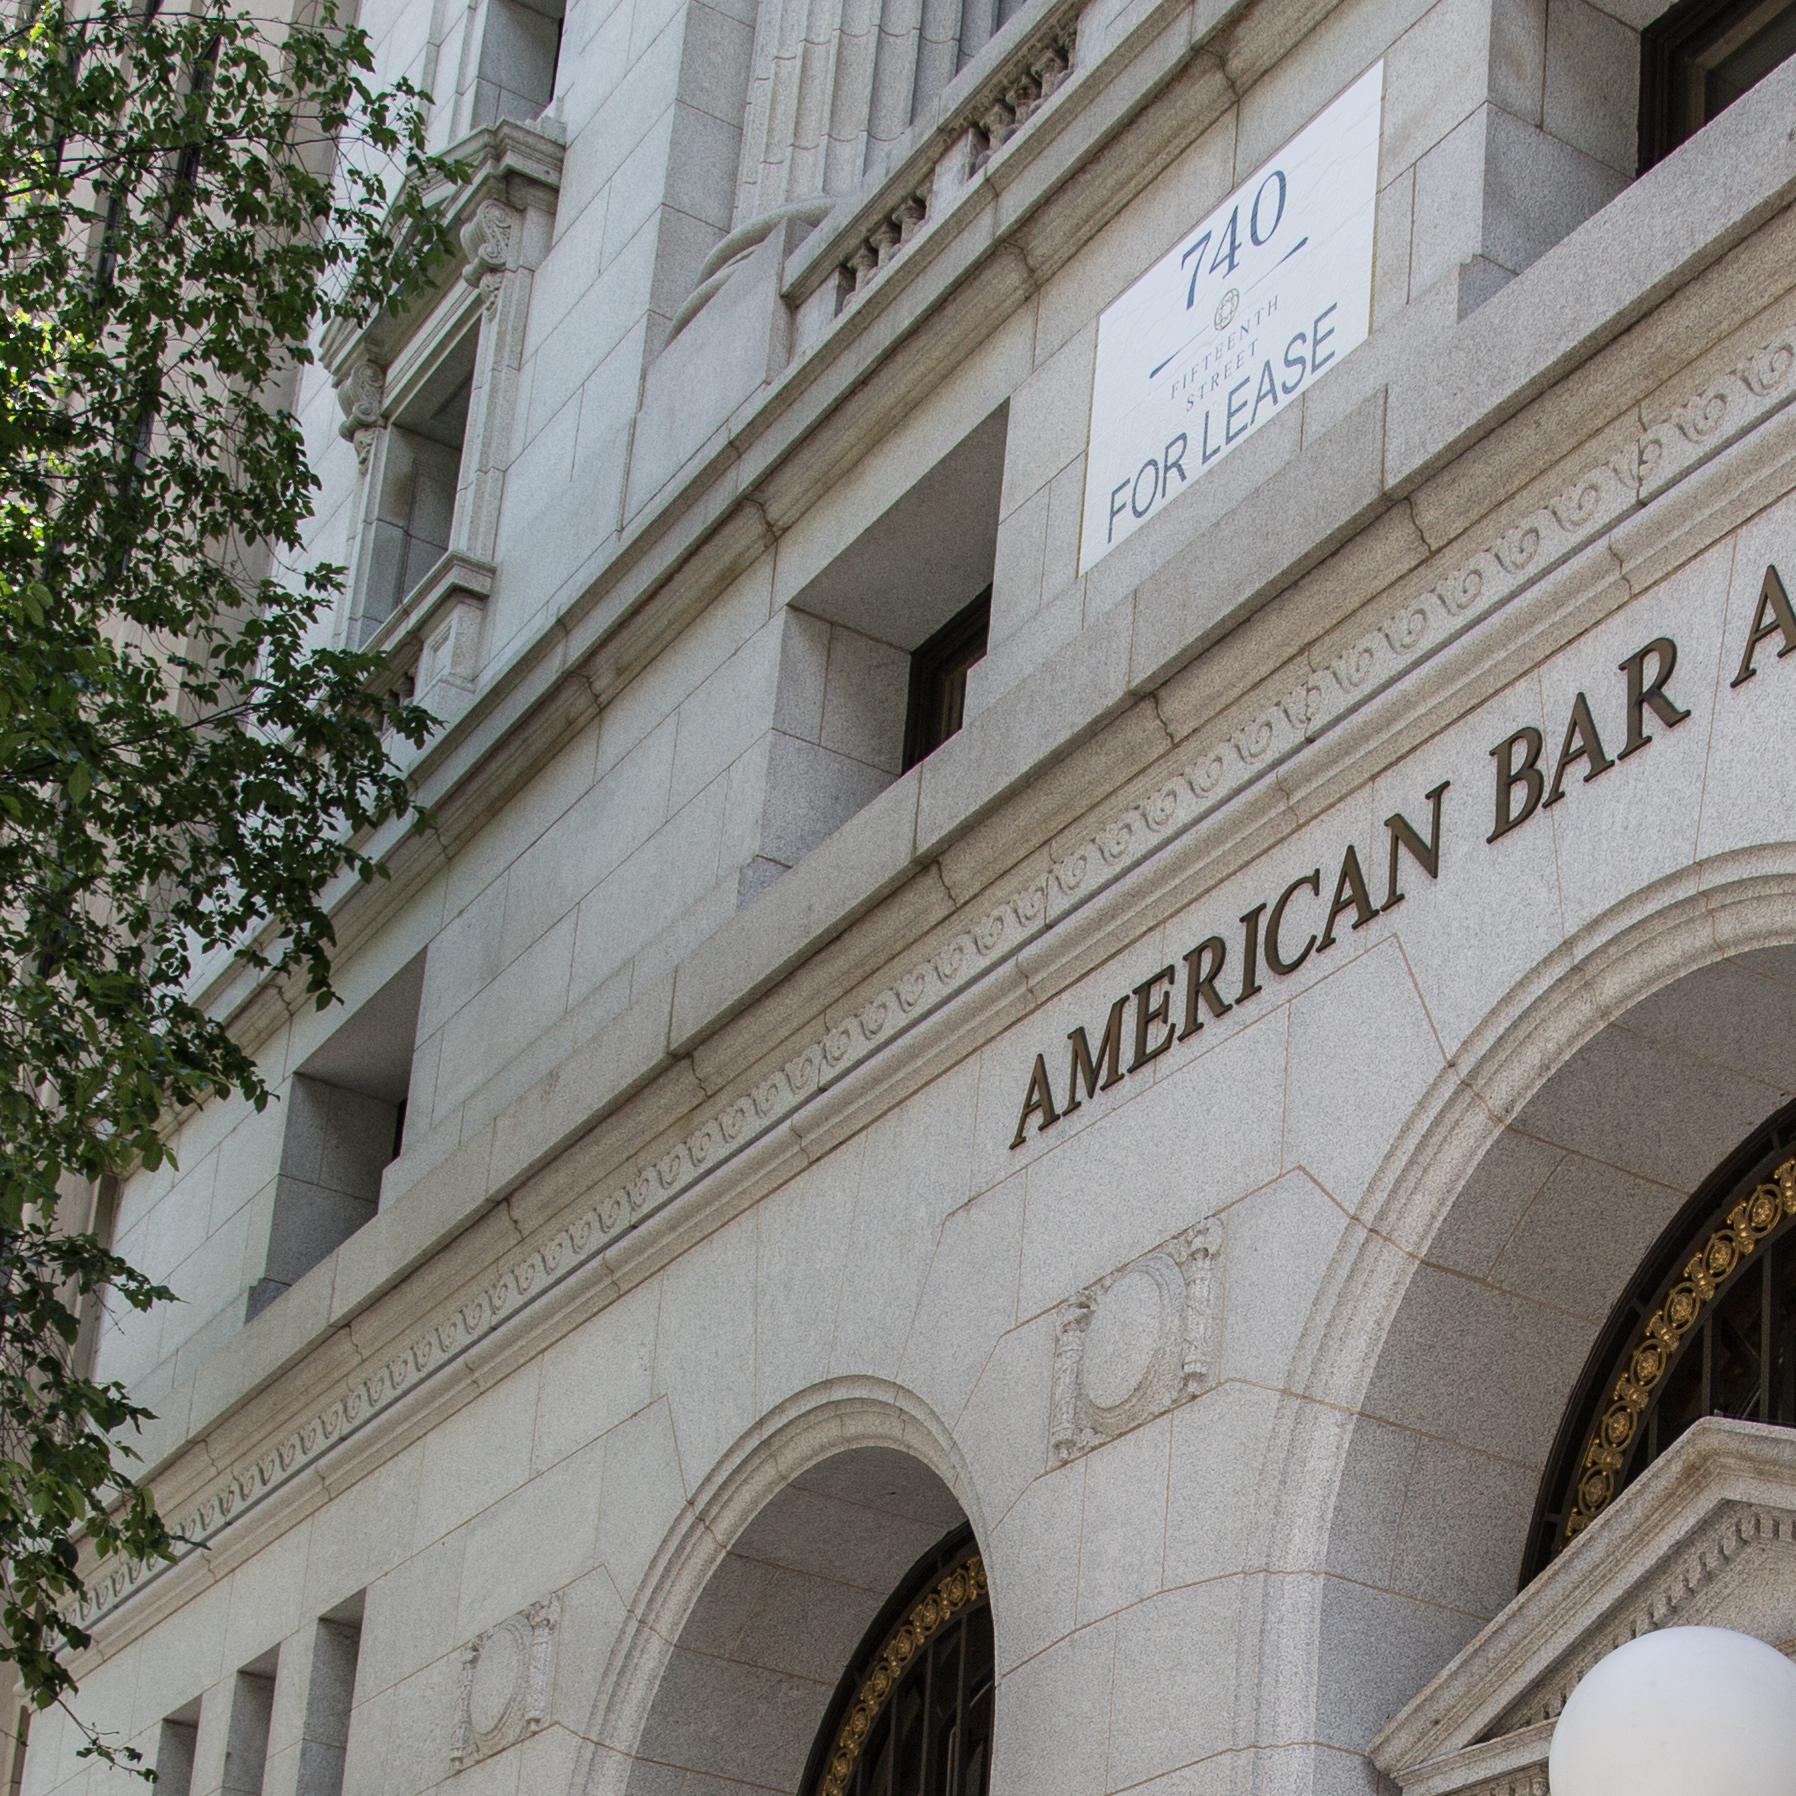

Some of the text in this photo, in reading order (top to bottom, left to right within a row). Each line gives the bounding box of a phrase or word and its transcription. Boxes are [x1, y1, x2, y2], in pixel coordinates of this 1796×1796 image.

[1180, 169, 1287, 311] 740
[1171, 295, 1279, 400] FIFTEENTH
[1186, 338, 1259, 412] STREET
[1107, 302, 1338, 544] FOR LEASE
[1009, 780, 1450, 1151] AMERICAN
[1486, 637, 1692, 844] BAR
